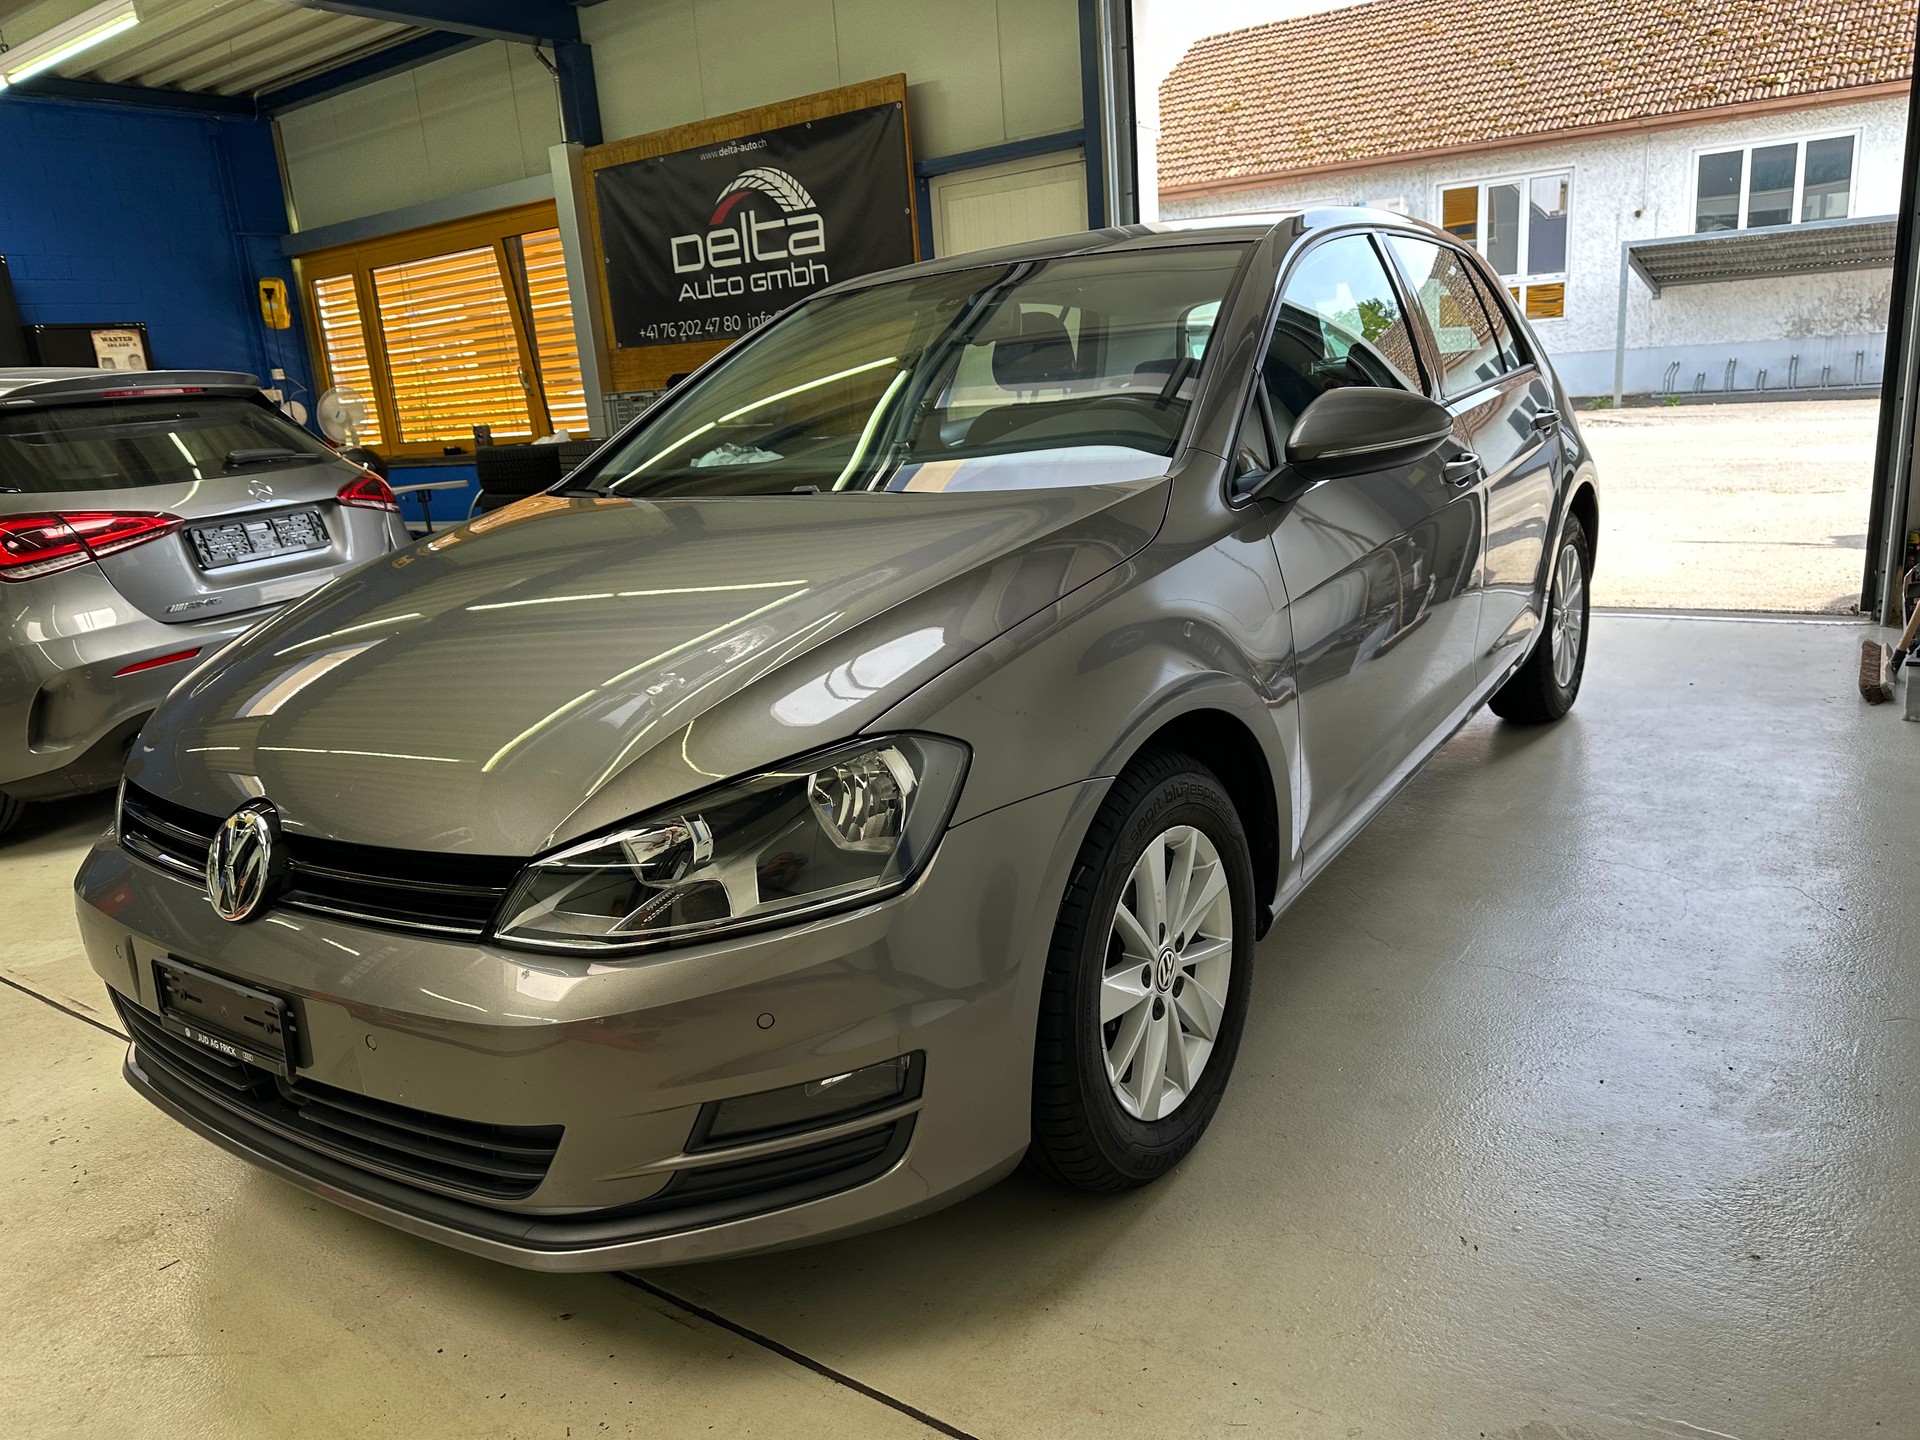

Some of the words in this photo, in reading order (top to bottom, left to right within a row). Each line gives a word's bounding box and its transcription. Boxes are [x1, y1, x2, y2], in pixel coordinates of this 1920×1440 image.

[699, 138, 767, 160] www.delta-auto.ch
[679, 273, 744, 302] Auto
[639, 324, 659, 339] +41
[660, 322, 677, 338] 76
[679, 319, 702, 337] 202
[705, 317, 720, 333] 47
[723, 315, 741, 332] 80
